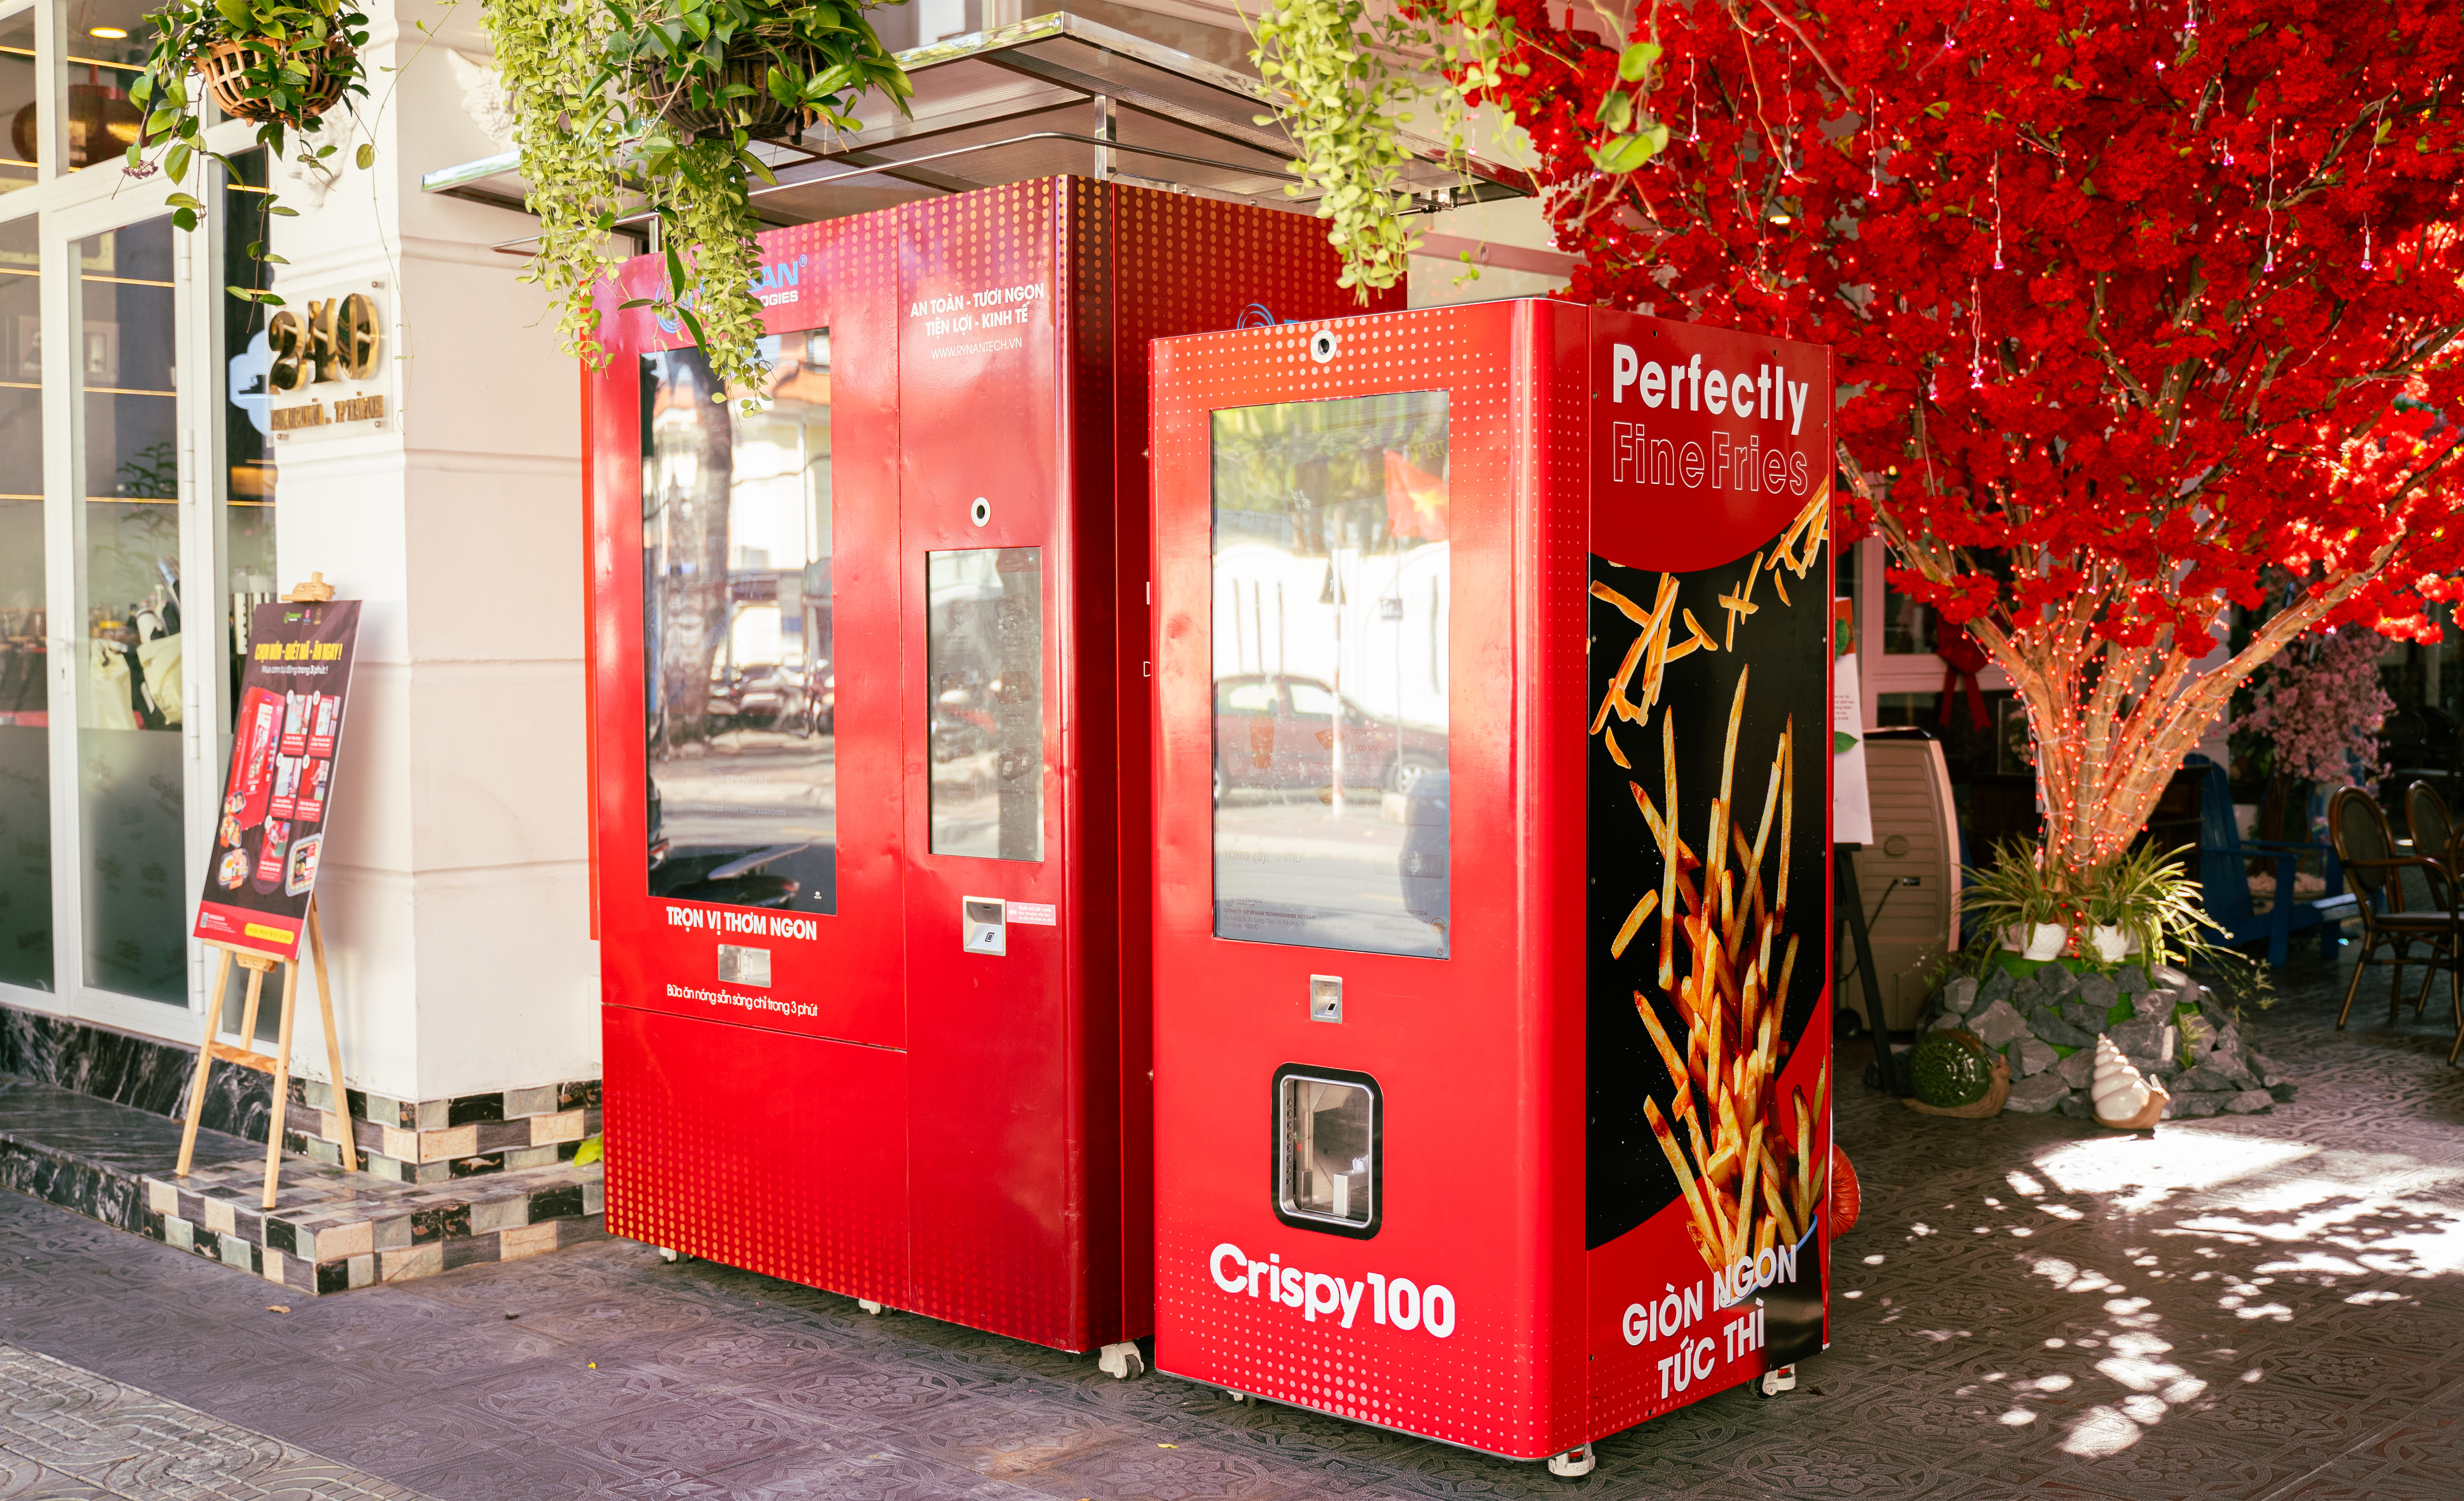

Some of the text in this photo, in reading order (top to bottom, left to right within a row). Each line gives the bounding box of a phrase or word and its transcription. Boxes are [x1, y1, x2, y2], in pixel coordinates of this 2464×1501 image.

[910, 301, 927, 317] AN
[930, 293, 963, 314] TOÀN
[973, 288, 1001, 308] TƯƠI
[1005, 283, 1044, 303] NGON
[925, 316, 949, 339] TIỆN
[953, 314, 972, 335] LỢI
[982, 310, 1012, 328] KINH
[1015, 300, 1030, 324] TẾ
[931, 337, 1022, 359] WWW.RYNANTECH.VN
[1613, 343, 1808, 436] Perfectly
[1283, 853, 1302, 863] VND
[666, 906, 816, 941] TRỌN VỊ THƠM NGON
[1373, 925, 1427, 934] service@rynantech.com
[667, 984, 818, 1017] Bữa ăn nóng sẵn sàng chỉ trong 3 phút
[1623, 1244, 1796, 1346] GIÒN NGON
[1658, 1297, 1764, 1399] TỨC THÌ
